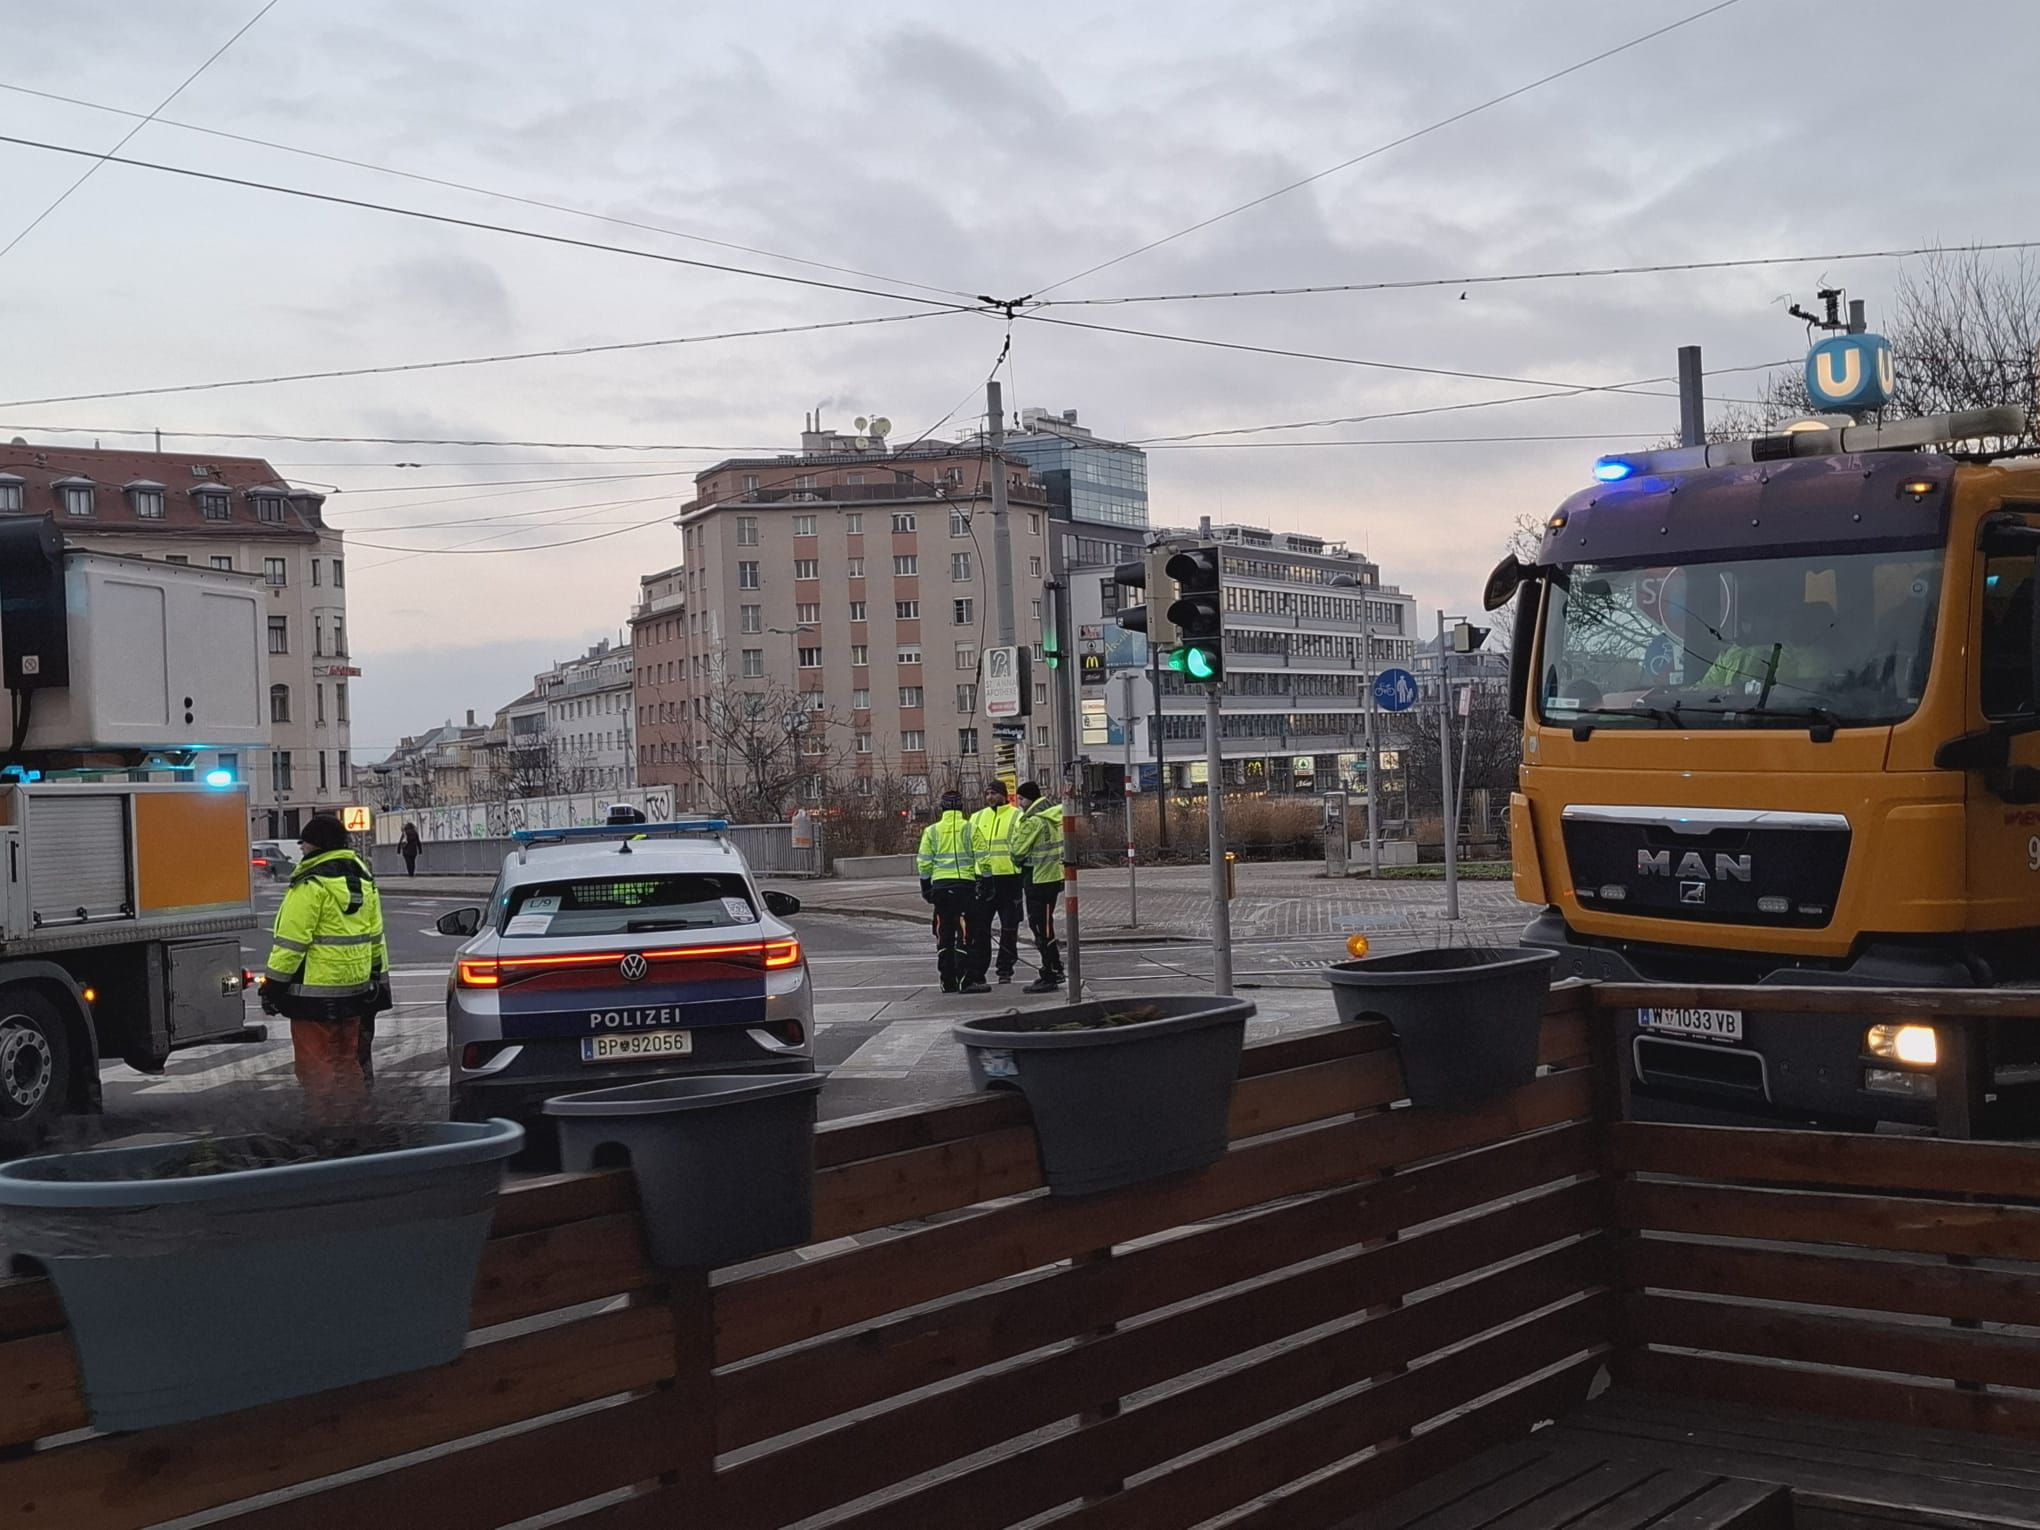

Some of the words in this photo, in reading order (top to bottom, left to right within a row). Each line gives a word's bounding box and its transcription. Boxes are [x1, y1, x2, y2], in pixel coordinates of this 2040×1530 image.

[1817, 347, 1860, 397] U
[1878, 347, 1894, 395] U
[1637, 849, 1751, 881] MAN
[590, 1008, 680, 1029] POLIZEI
[598, 1039, 618, 1056] BP
[631, 1034, 683, 1053] 92056
